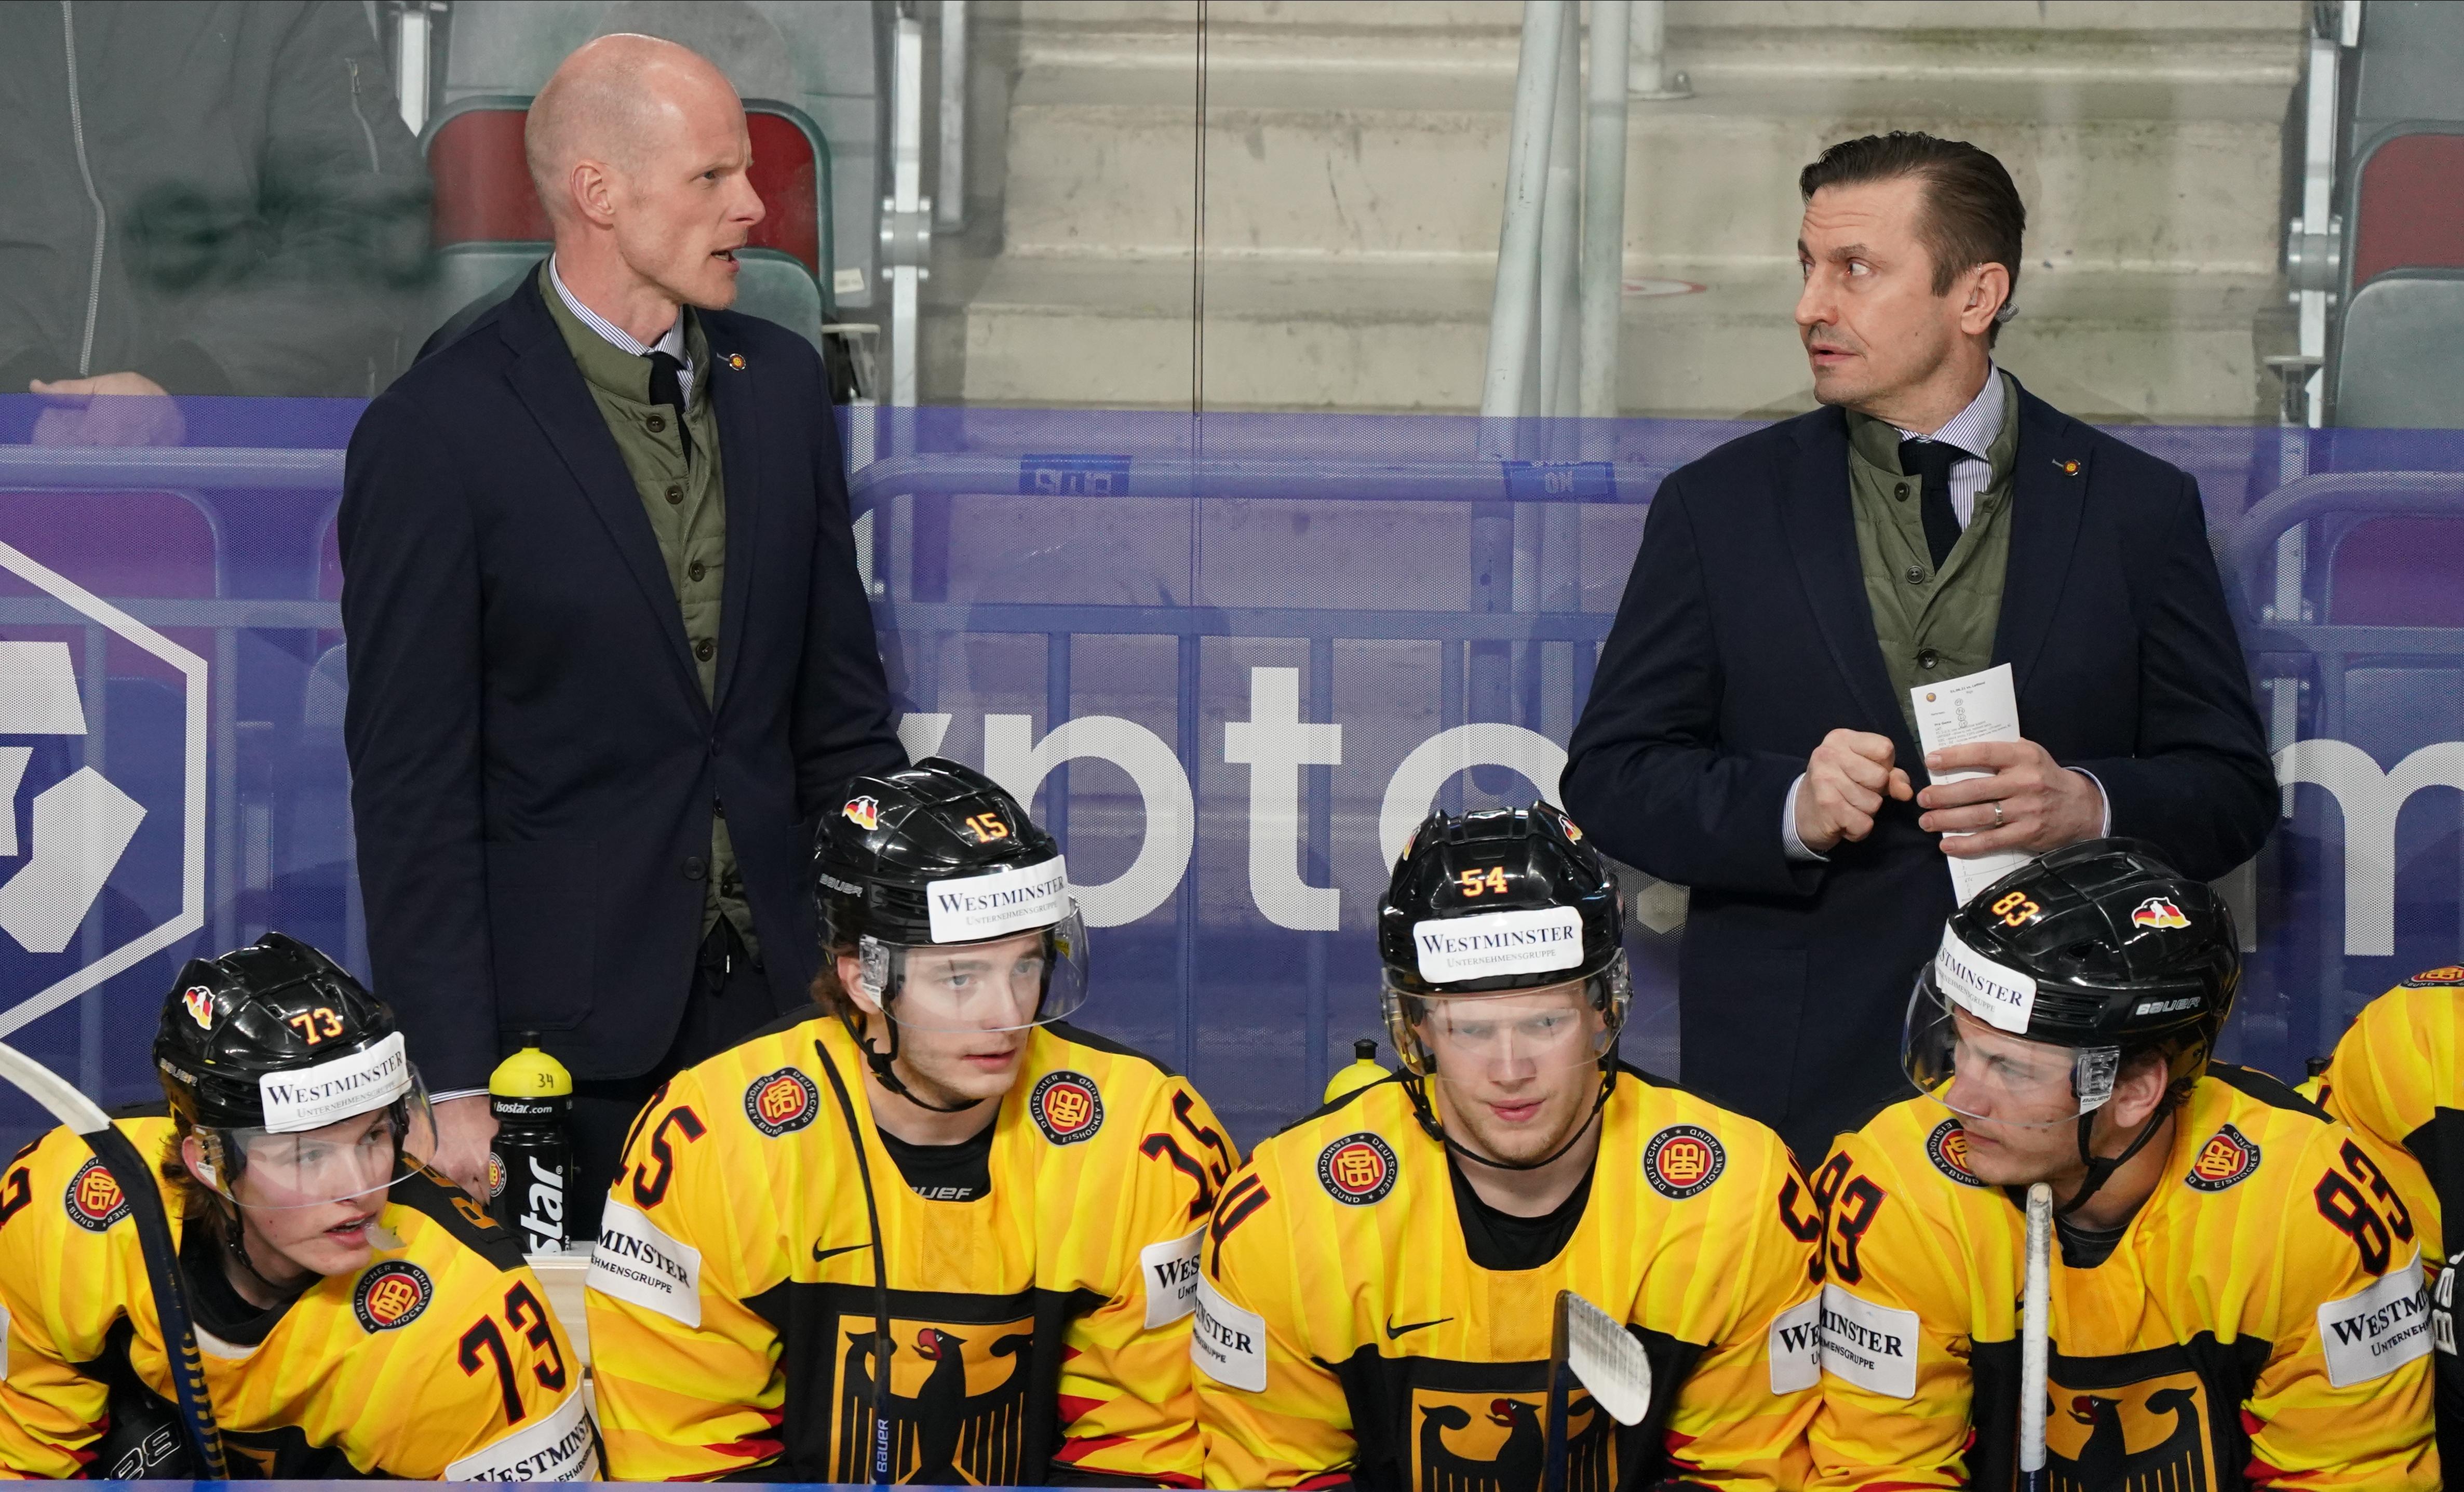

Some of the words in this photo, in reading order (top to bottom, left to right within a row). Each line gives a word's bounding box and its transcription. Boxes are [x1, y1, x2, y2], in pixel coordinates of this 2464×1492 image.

[965, 812, 1008, 844] 15
[937, 876, 1065, 914] WESTMINSTER
[1461, 866, 1509, 897] 54
[966, 900, 1058, 926] UNTERNEHMENSGRUPPE
[1991, 891, 2040, 927] 83
[1422, 925, 1574, 955] WESTMINSTER
[1447, 950, 1556, 967] UNTERNEHMENSGRUPPE
[2135, 997, 2201, 1016] BAUER
[290, 1007, 344, 1045] 73
[266, 1051, 403, 1106] WESTMINSTER
[537, 1073, 554, 1088] 34
[297, 1081, 396, 1118] UNTERNEHMENSGRUPPE
[1032, 1074, 1059, 1128] DEUTSCHER
[1372, 1138, 1395, 1194] DEUTSCHER
[1647, 1133, 1669, 1191] DEUTSCHER
[2313, 1137, 2416, 1278] 83
[356, 1265, 391, 1320] DEUTSCHER
[457, 1279, 567, 1427] 73
[877, 1419, 888, 1472] BAUER
